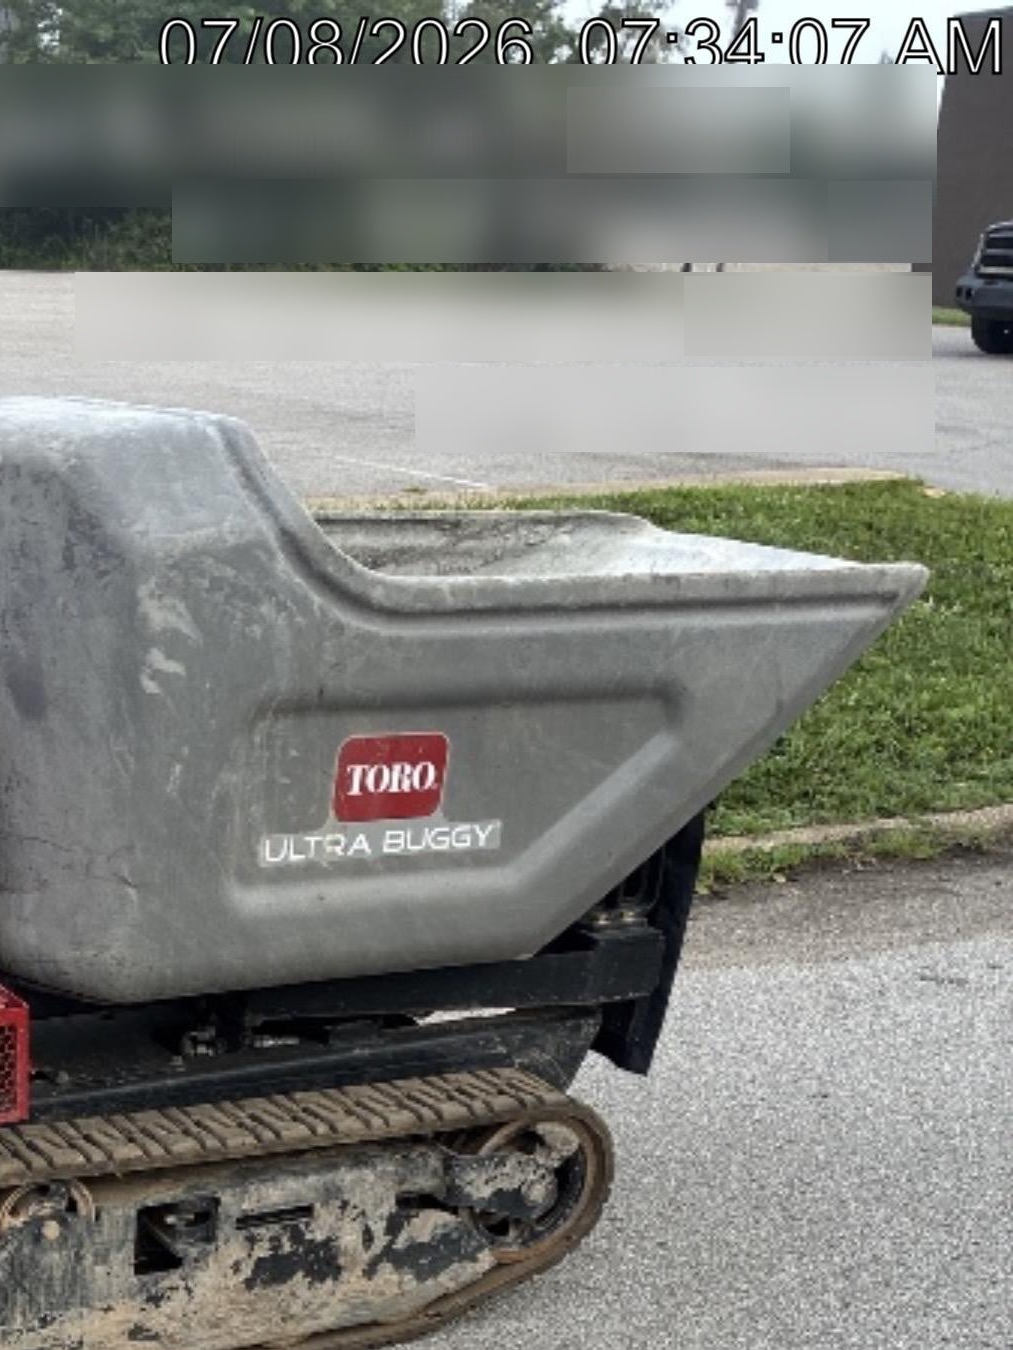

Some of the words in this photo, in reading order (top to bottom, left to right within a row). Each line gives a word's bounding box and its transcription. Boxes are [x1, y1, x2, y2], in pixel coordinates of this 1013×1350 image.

[347, 761, 435, 796] TORO
[264, 835, 372, 862] ULTRA
[382, 824, 494, 853] BUGGY
